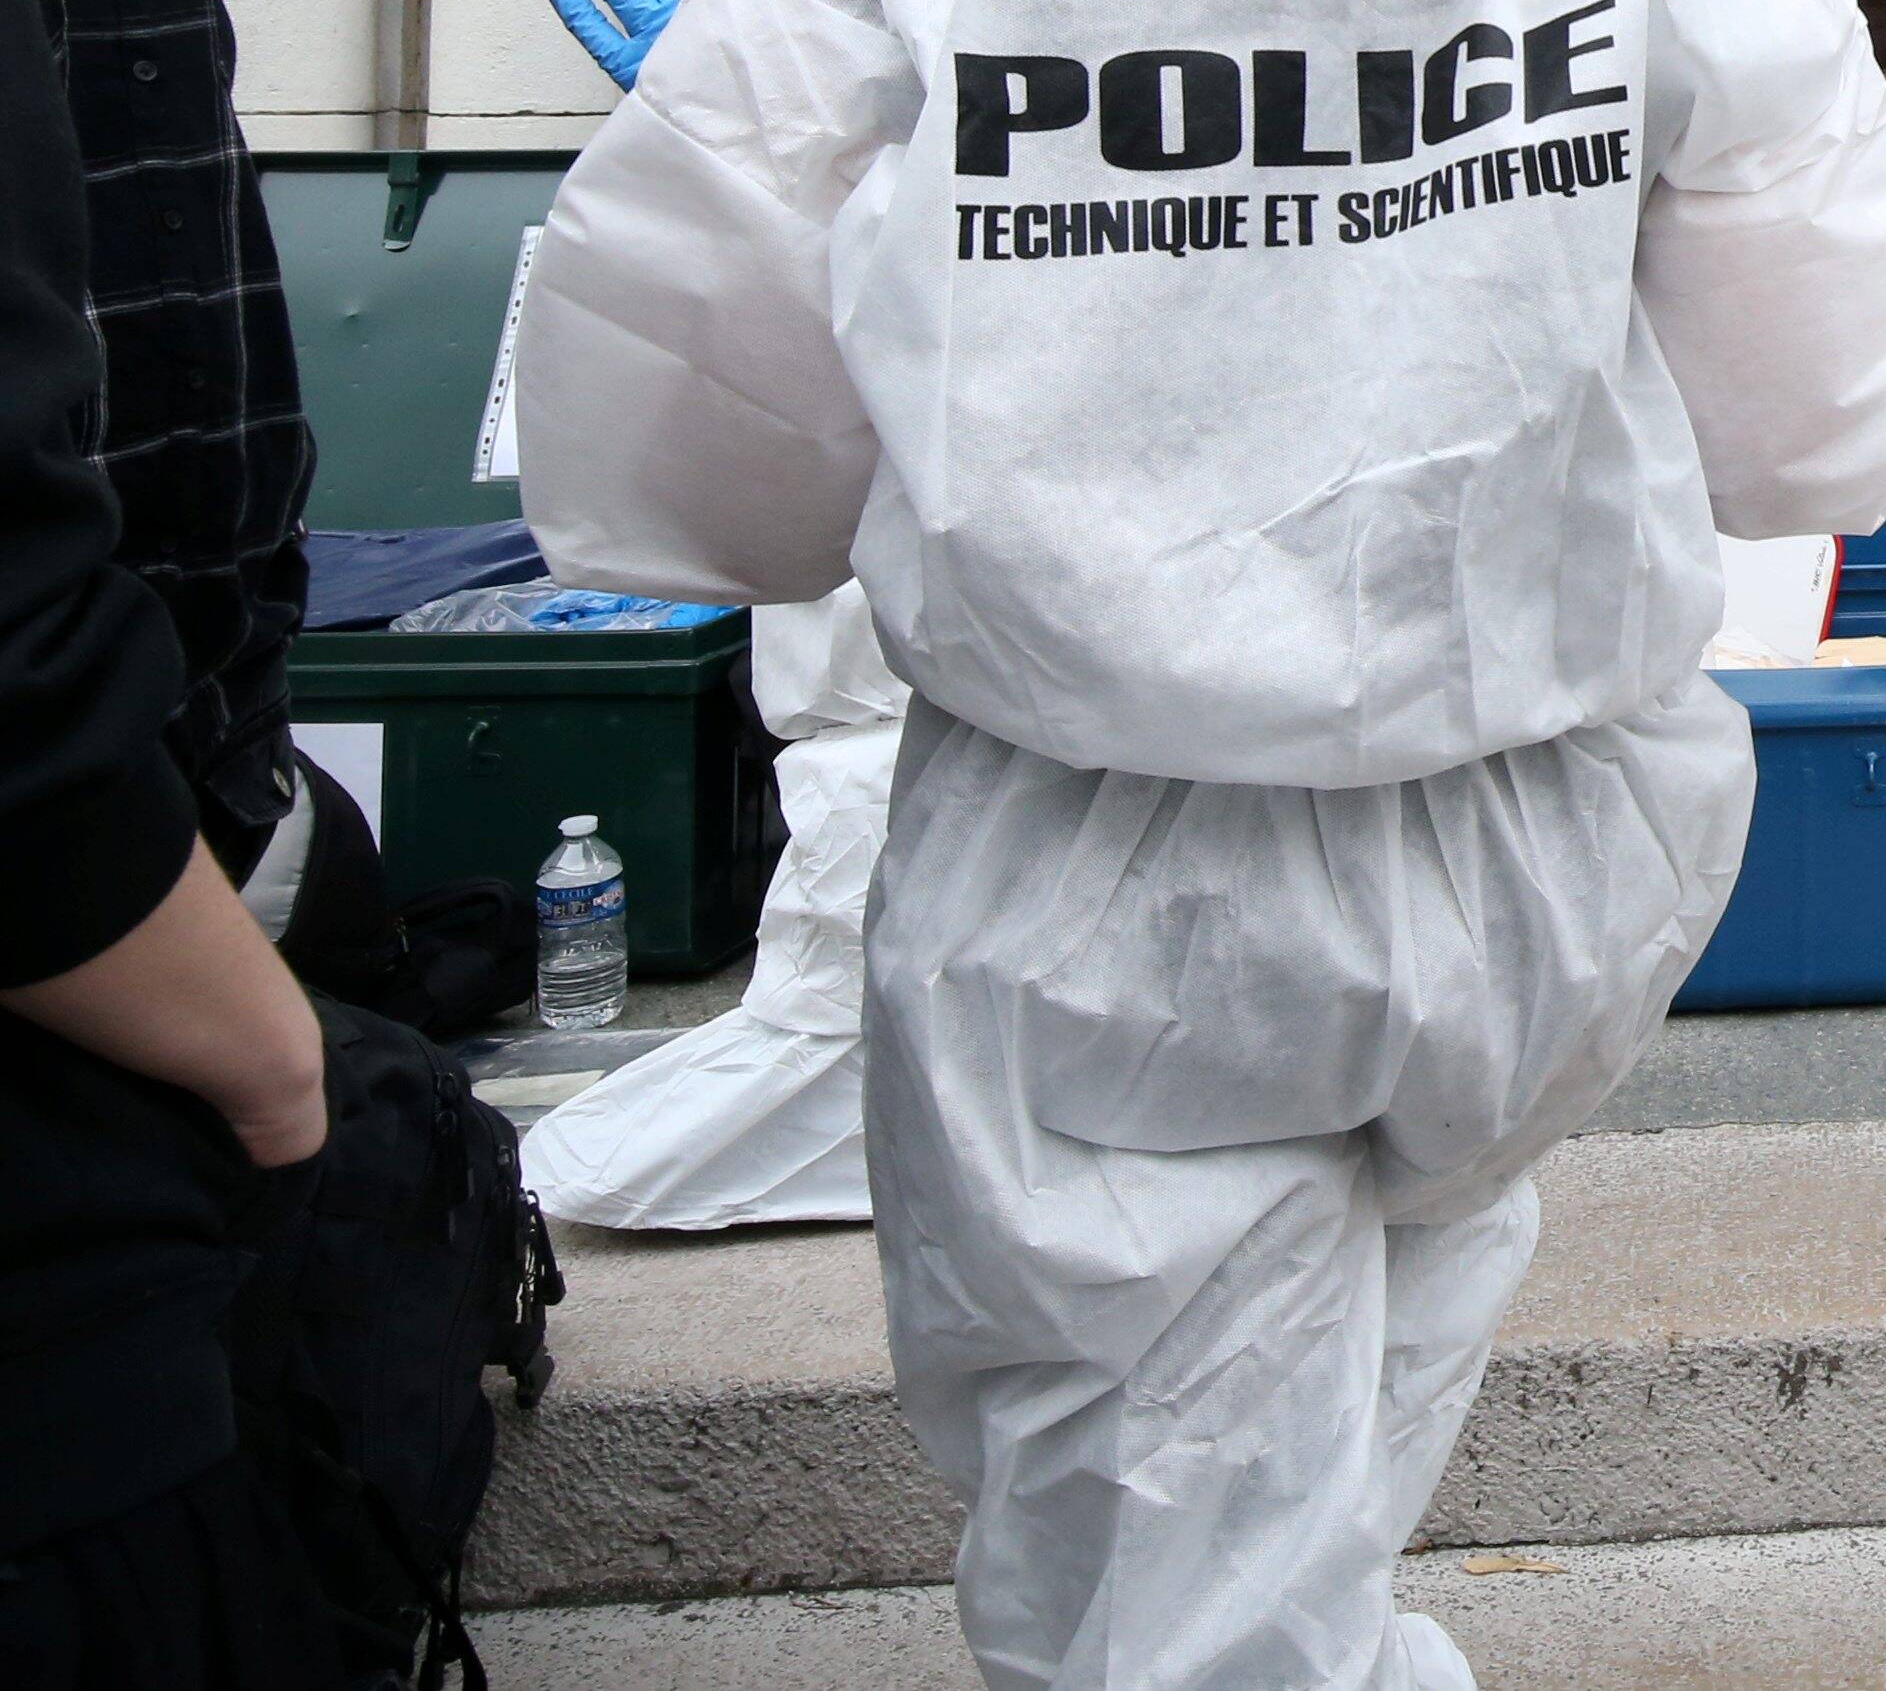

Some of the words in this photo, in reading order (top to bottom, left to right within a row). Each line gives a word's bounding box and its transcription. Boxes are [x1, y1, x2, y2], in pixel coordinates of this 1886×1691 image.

[955, 195, 1249, 260] TECHNIQUE
[1264, 194, 1319, 248] ET
[1338, 128, 1632, 244] SCIENTIFIQUE
